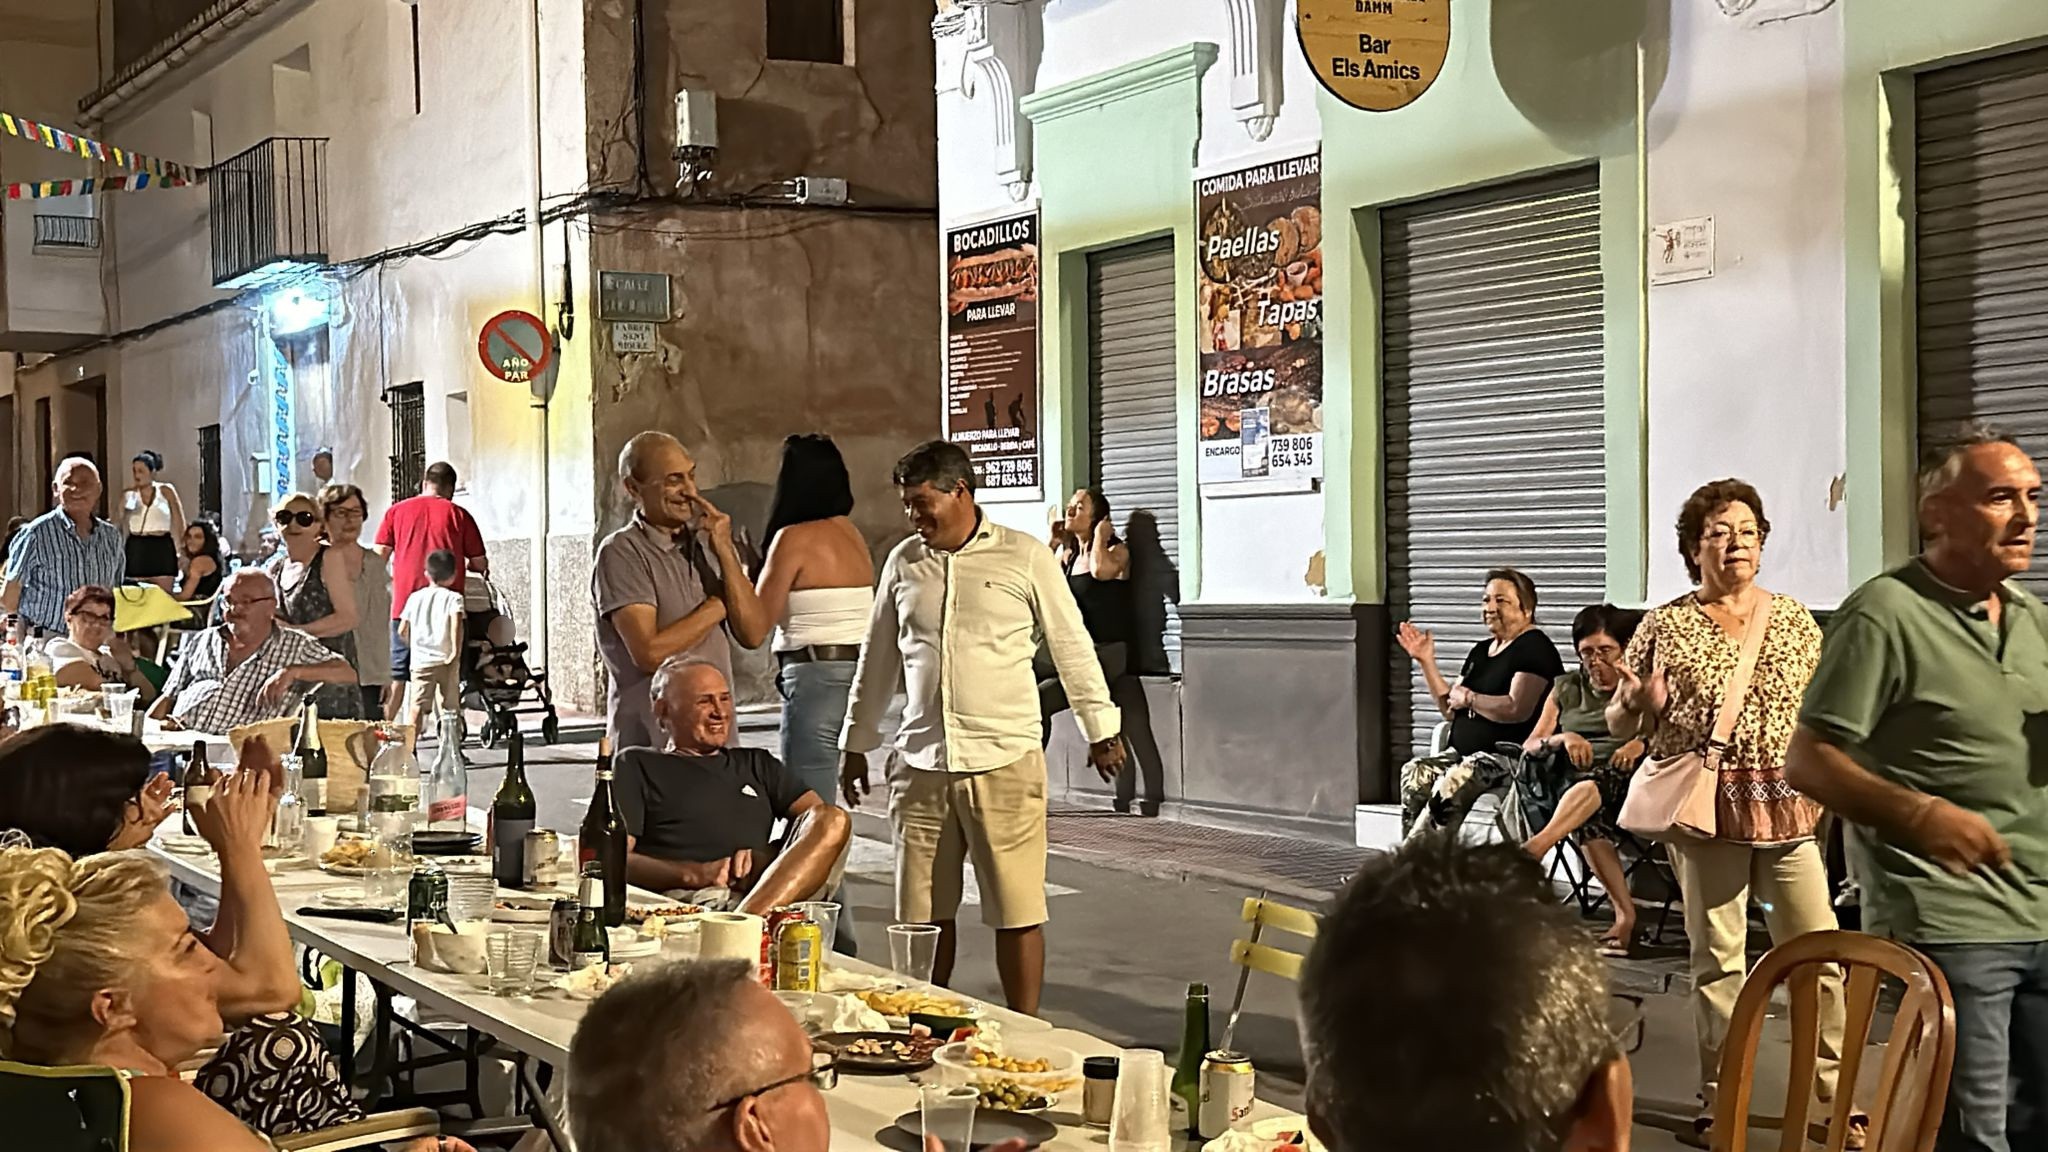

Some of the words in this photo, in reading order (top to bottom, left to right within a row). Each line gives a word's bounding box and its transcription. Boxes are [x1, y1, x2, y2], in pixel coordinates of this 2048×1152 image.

[1356, 0, 1392, 14] DAMM
[1359, 34, 1391, 54] Bar
[1332, 58, 1360, 77] Els
[1363, 59, 1420, 80] Amics
[1202, 173, 1244, 196] COMIDA
[1245, 166, 1275, 188] PARA
[1277, 156, 1319, 181] LLEVAR
[953, 220, 1030, 252] BOCADILLOS
[1206, 226, 1280, 261] Paellas
[966, 307, 987, 322] PARA
[987, 302, 1016, 318] LLEVAR
[1257, 298, 1319, 330] Tapas
[503, 357, 529, 368] AÑO
[504, 371, 529, 381] PAR
[1203, 368, 1276, 397] Brasas
[951, 431, 981, 442] ALMUERZO
[982, 429, 997, 440] PARA
[998, 427, 1019, 438] LLEVAR
[1271, 439, 1289, 453] 739
[1292, 437, 1312, 451] 806
[985, 461, 1000, 474] 962
[1001, 460, 1015, 472] 739
[1017, 459, 1032, 472] 806
[1271, 454, 1291, 467] 654
[1294, 452, 1312, 466] 345
[985, 474, 1000, 487] 687
[1002, 473, 1016, 486] 654
[1017, 472, 1033, 485] 345
